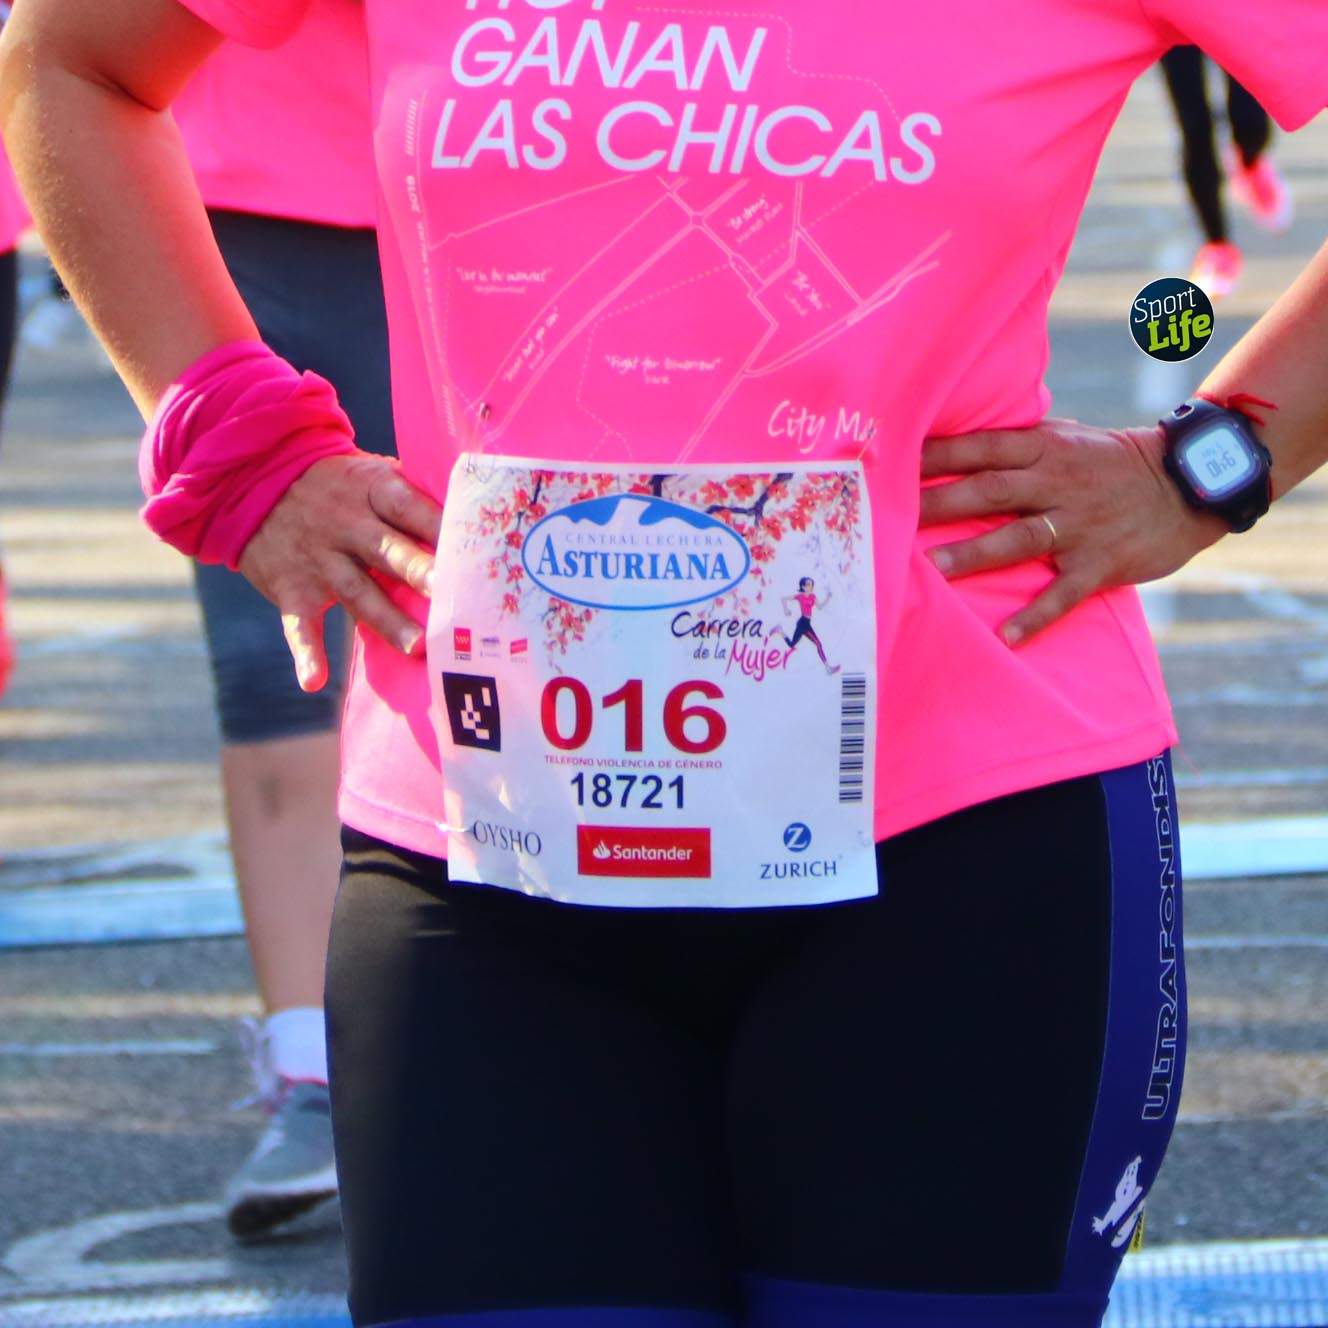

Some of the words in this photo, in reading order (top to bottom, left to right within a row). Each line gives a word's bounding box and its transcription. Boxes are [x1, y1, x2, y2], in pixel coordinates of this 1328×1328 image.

[450, 17, 768, 92] GANAN
[431, 98, 572, 171] LAS
[595, 101, 943, 185] CHICAS
[767, 399, 826, 455] City
[536, 533, 732, 581] ASTURIANA
[564, 533, 640, 546] CENTRAL
[645, 534, 724, 547] LECHERA
[670, 611, 764, 640] Carrera
[692, 641, 712, 660] de
[714, 642, 727, 661] la
[726, 637, 795, 682] Mujer
[540, 675, 728, 754] 016
[596, 759, 656, 769] VIOLENCIA
[657, 760, 672, 769] DE
[570, 772, 684, 810] 18721
[472, 818, 542, 858] OYSHO
[613, 844, 693, 863] Santander
[759, 860, 838, 880] ZURICH
